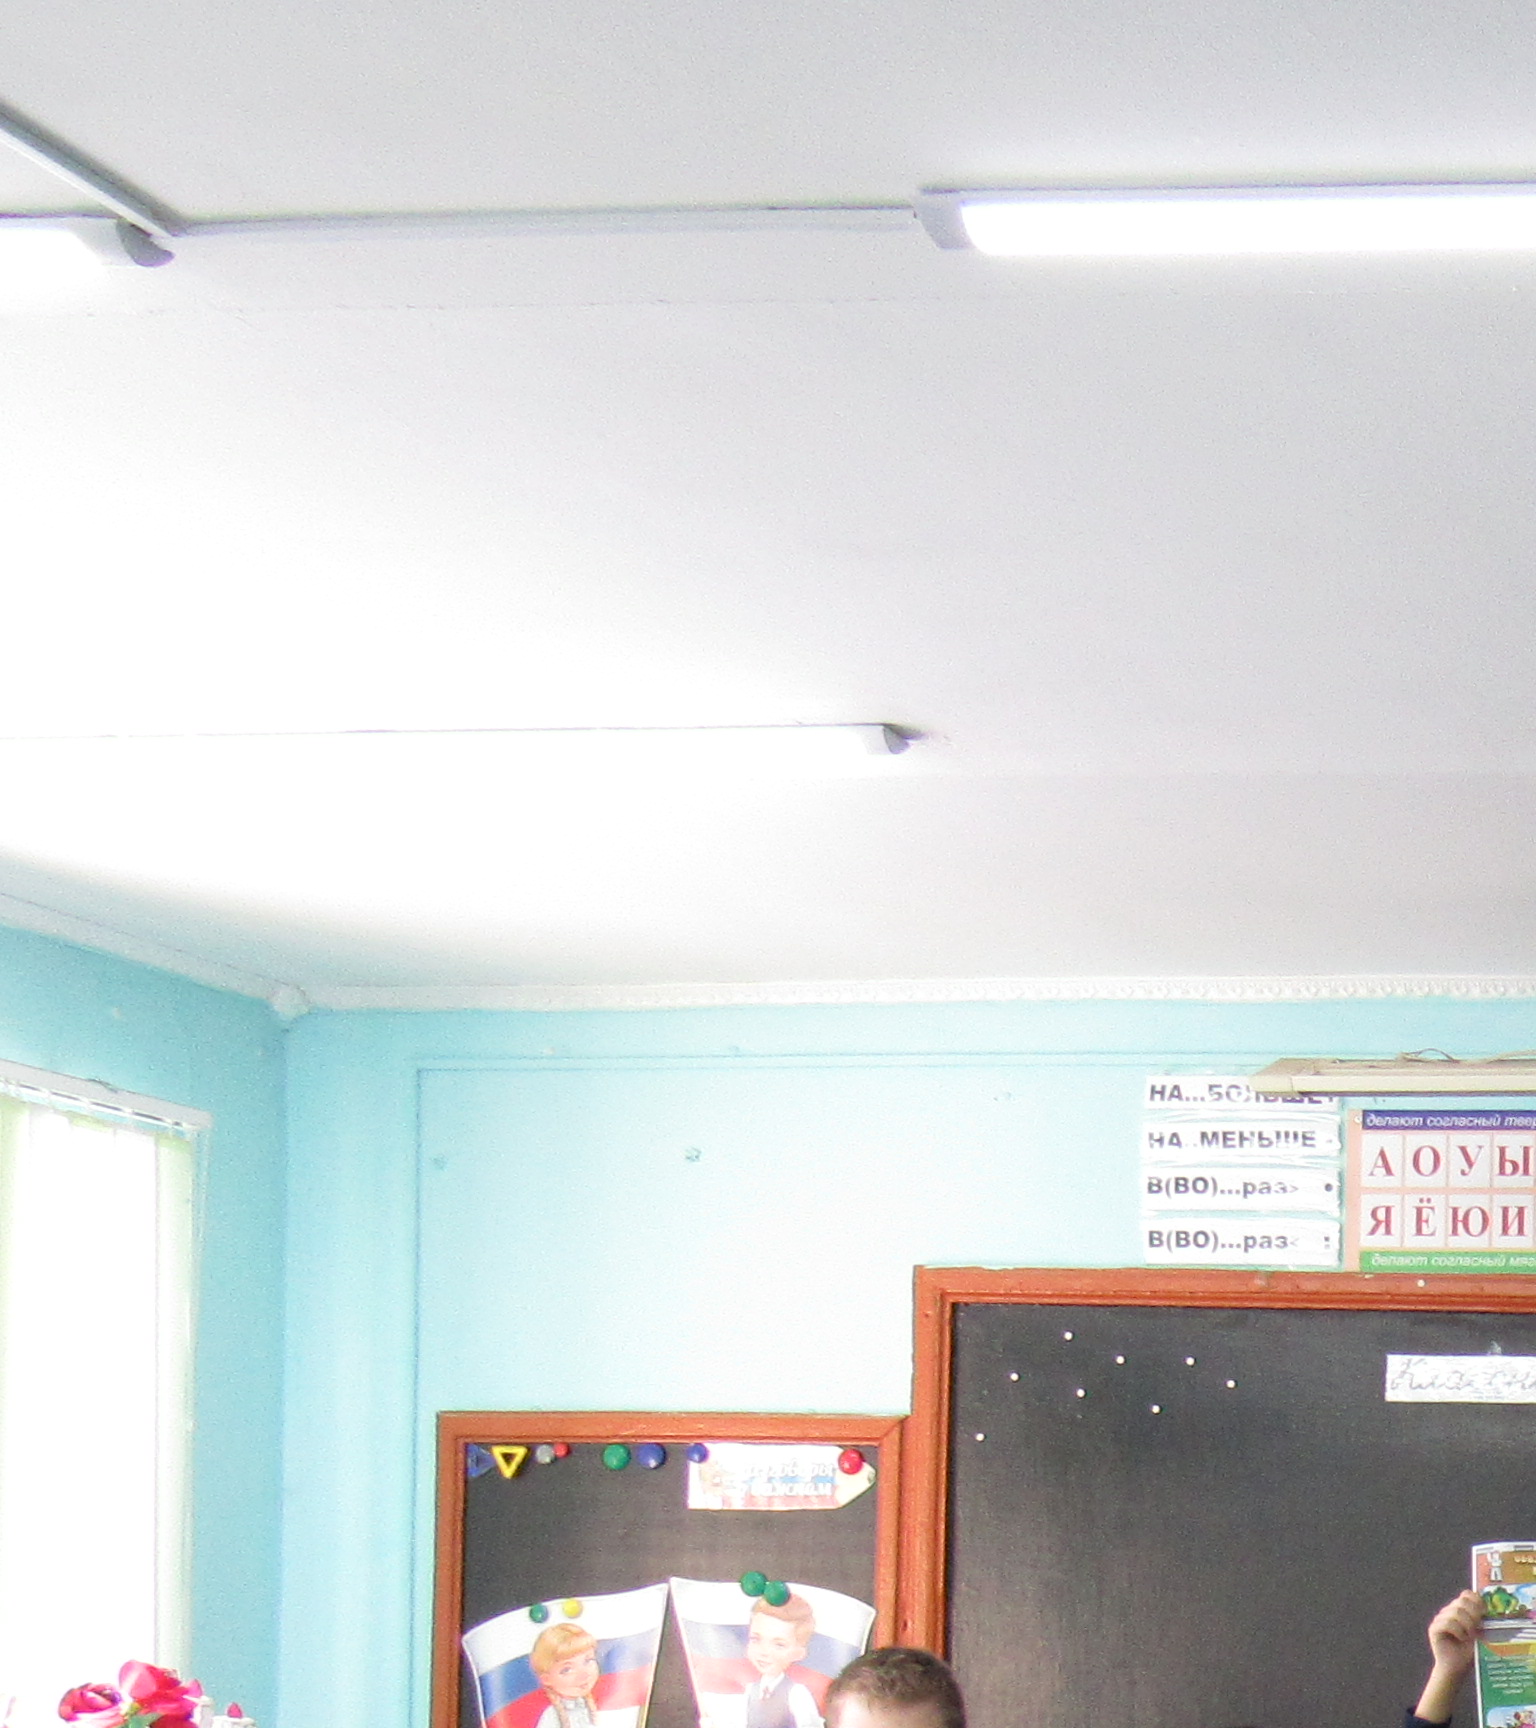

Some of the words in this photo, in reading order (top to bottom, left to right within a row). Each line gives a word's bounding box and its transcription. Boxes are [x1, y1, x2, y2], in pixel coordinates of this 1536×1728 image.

[1367, 1111, 1423, 1127] делают
[1427, 1111, 1500, 1127] согласный
[1368, 1146, 1395, 1177] А
[1412, 1145, 1441, 1177] О
[1457, 1146, 1483, 1177] У
[1497, 1146, 1533, 1177] Ы
[1366, 1206, 1395, 1236] Я
[1414, 1198, 1436, 1237] Ё
[1449, 1206, 1489, 1237] Ю
[1500, 1206, 1527, 1237] И
[1372, 1253, 1427, 1266] делают
[1431, 1253, 1505, 1267] согласный
